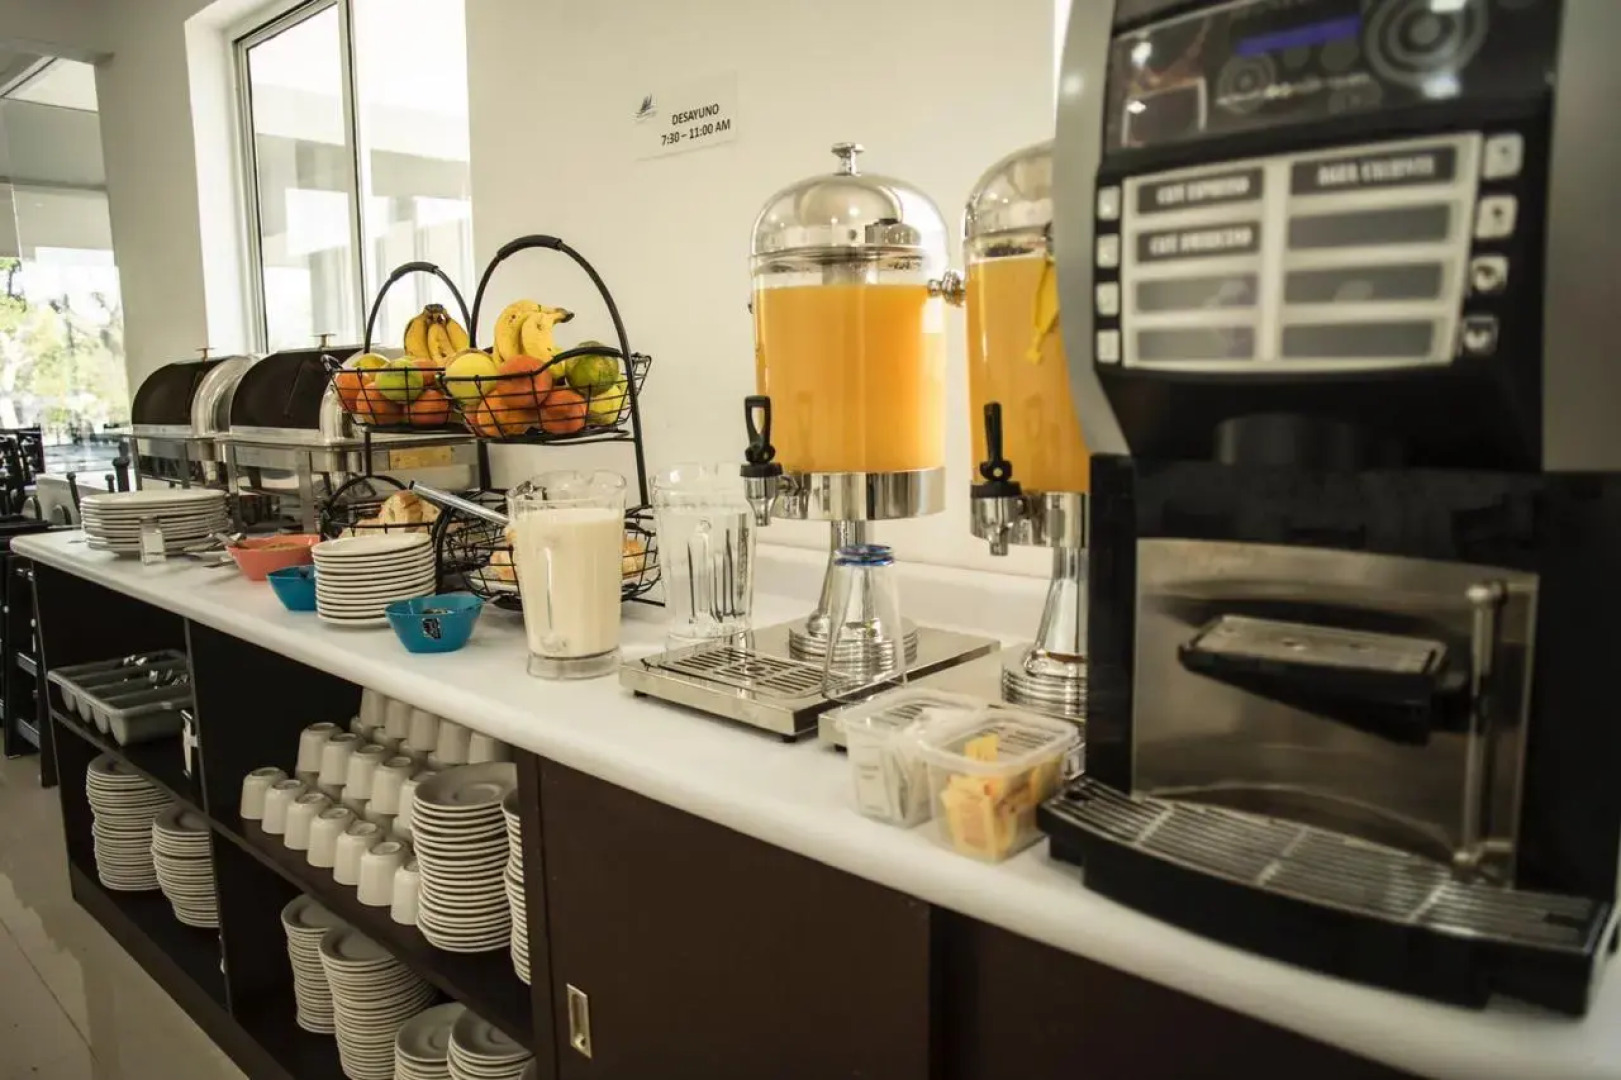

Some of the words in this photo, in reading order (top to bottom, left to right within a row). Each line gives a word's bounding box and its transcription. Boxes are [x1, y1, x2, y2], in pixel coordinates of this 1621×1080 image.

[671, 103, 719, 125] DESAYUNO
[661, 131, 680, 146] 7:30
[689, 123, 714, 139] 11:00
[715, 118, 731, 132] AM
